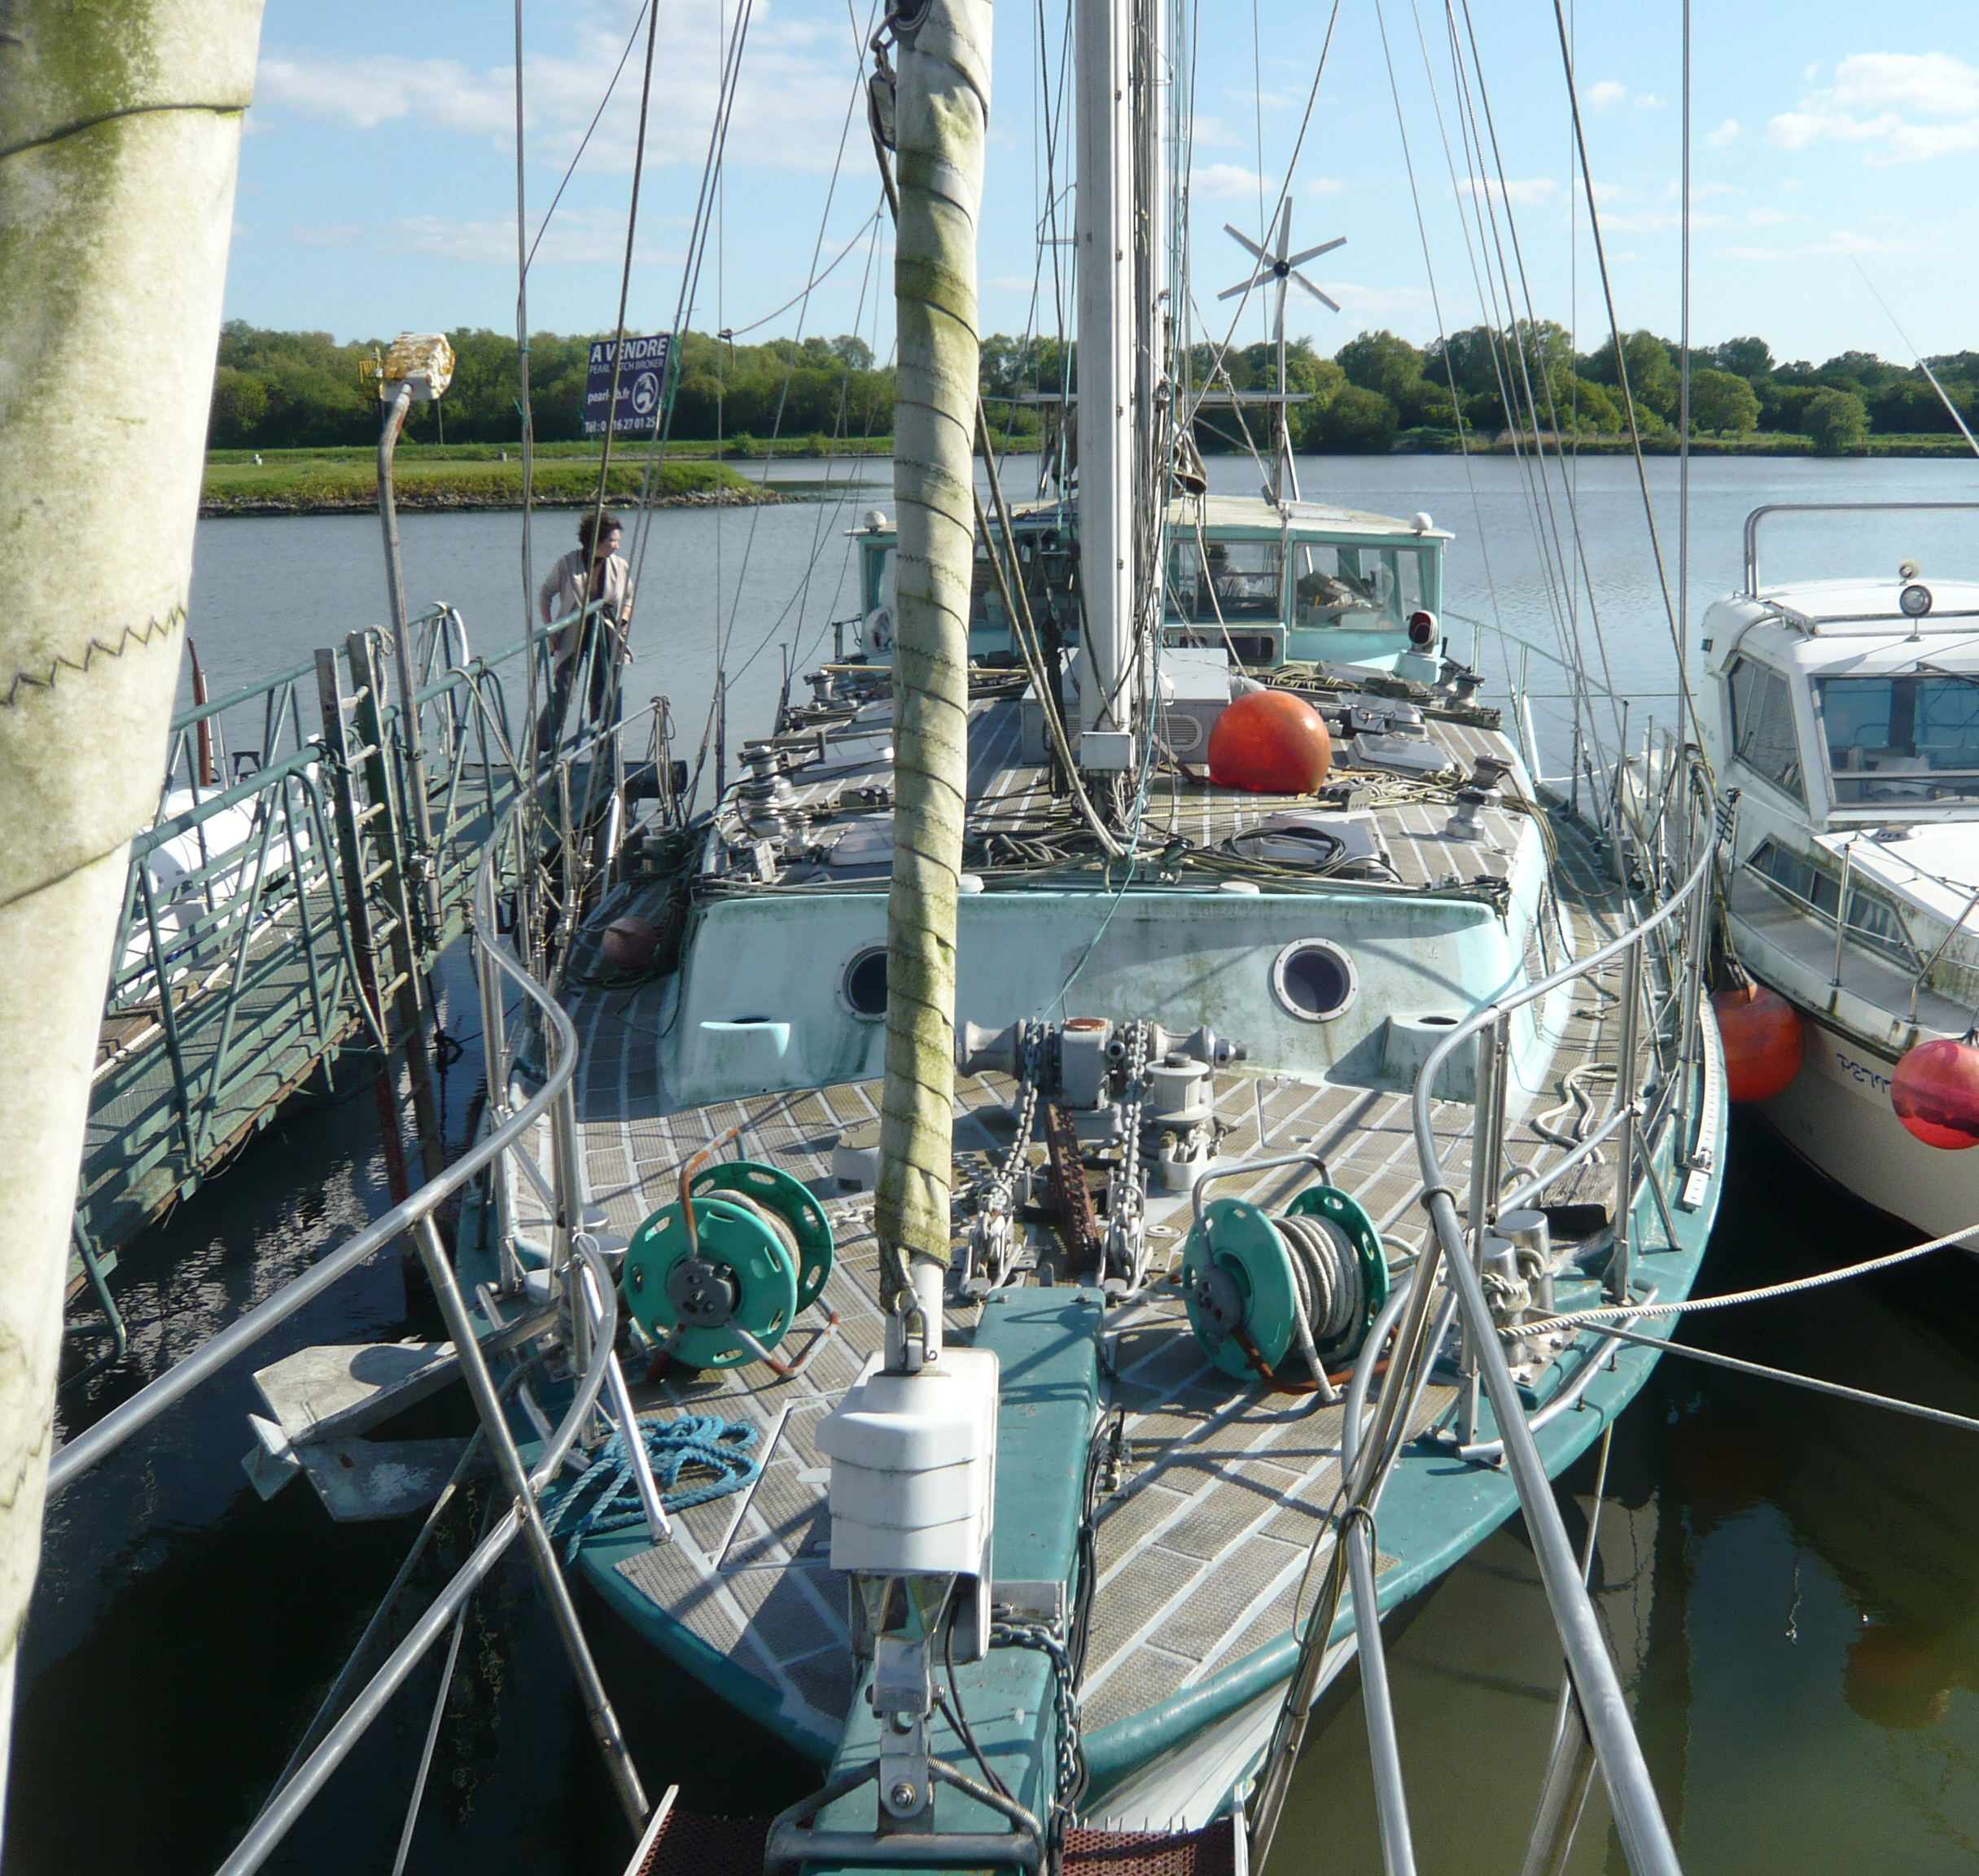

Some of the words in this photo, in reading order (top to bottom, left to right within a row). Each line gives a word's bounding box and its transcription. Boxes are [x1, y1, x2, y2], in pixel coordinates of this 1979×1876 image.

[591, 344, 602, 362] A
[589, 363, 611, 374] PEARL
[635, 358, 663, 370] BROKER
[588, 388, 630, 405] pearl-b.fr
[624, 419, 633, 430] 27
